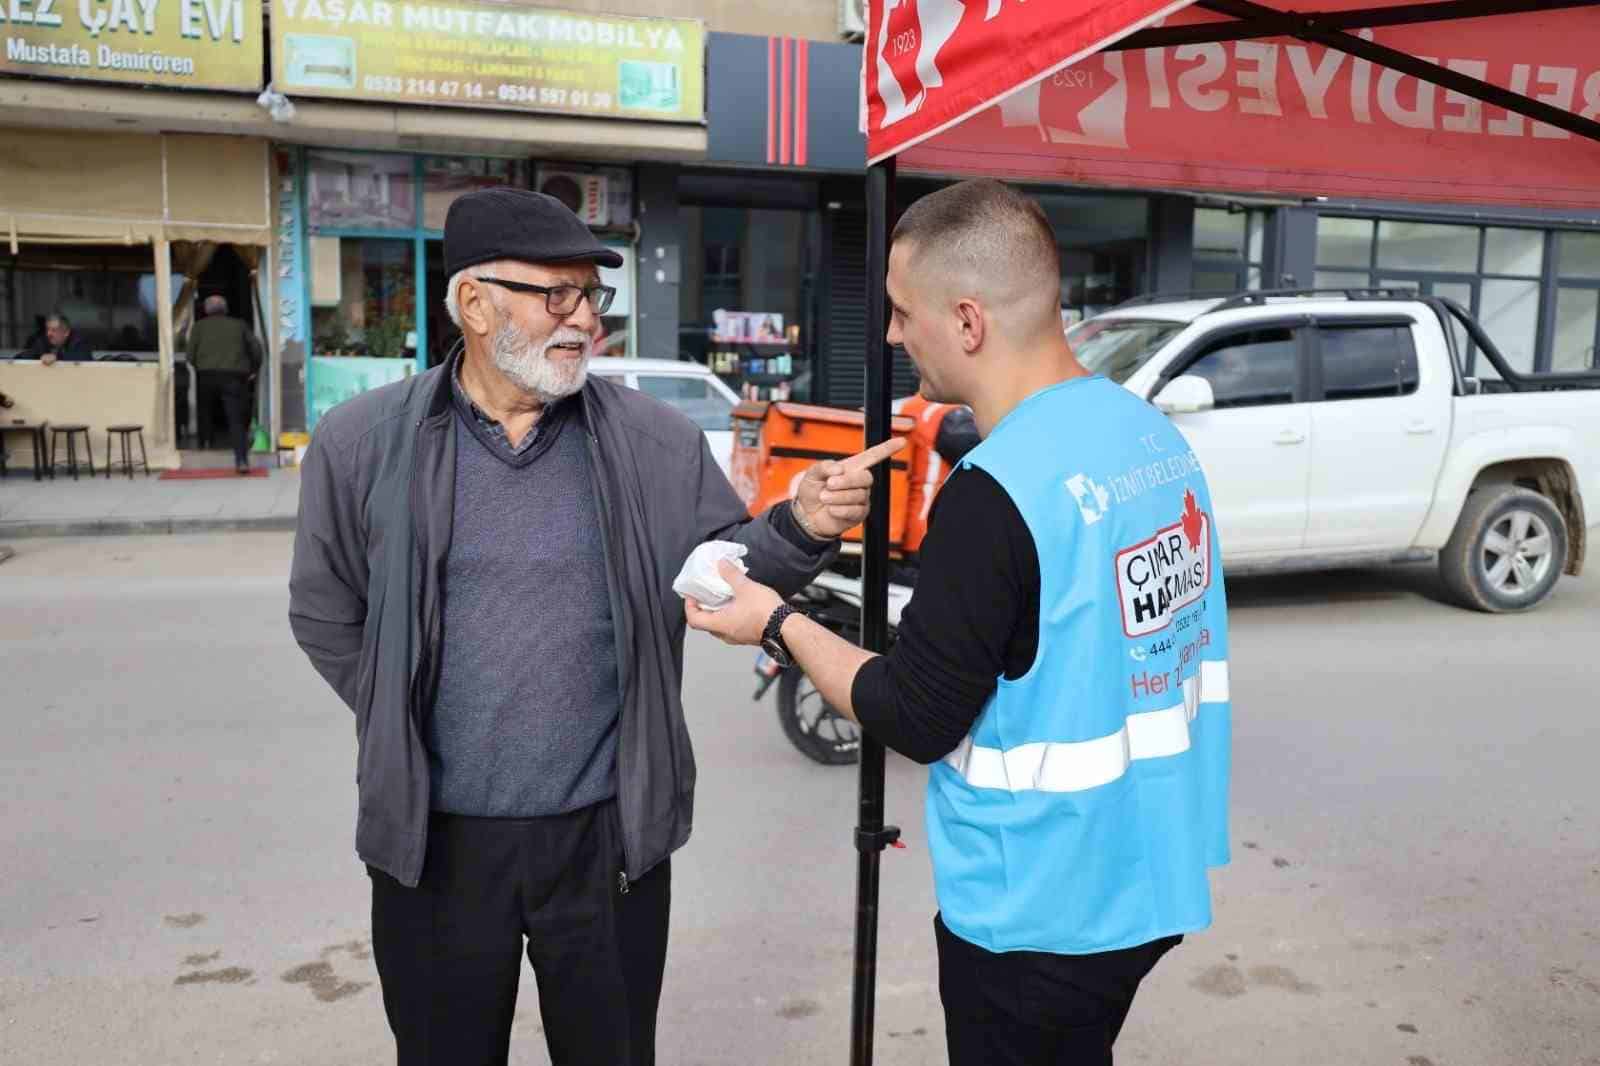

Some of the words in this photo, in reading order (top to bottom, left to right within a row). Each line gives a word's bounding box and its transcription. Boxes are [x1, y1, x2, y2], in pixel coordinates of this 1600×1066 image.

[0, 0, 62, 25] EZ
[79, 0, 159, 38] ÇAY
[403, 5, 543, 40] MUTFAK
[6, 37, 91, 66] Mustafa
[97, 44, 194, 76] Demirören
[893, 28, 916, 56] 1923
[406, 78, 435, 96] 214
[439, 80, 460, 98] 47
[463, 81, 482, 99] 14
[1130, 671, 1170, 699] Her
